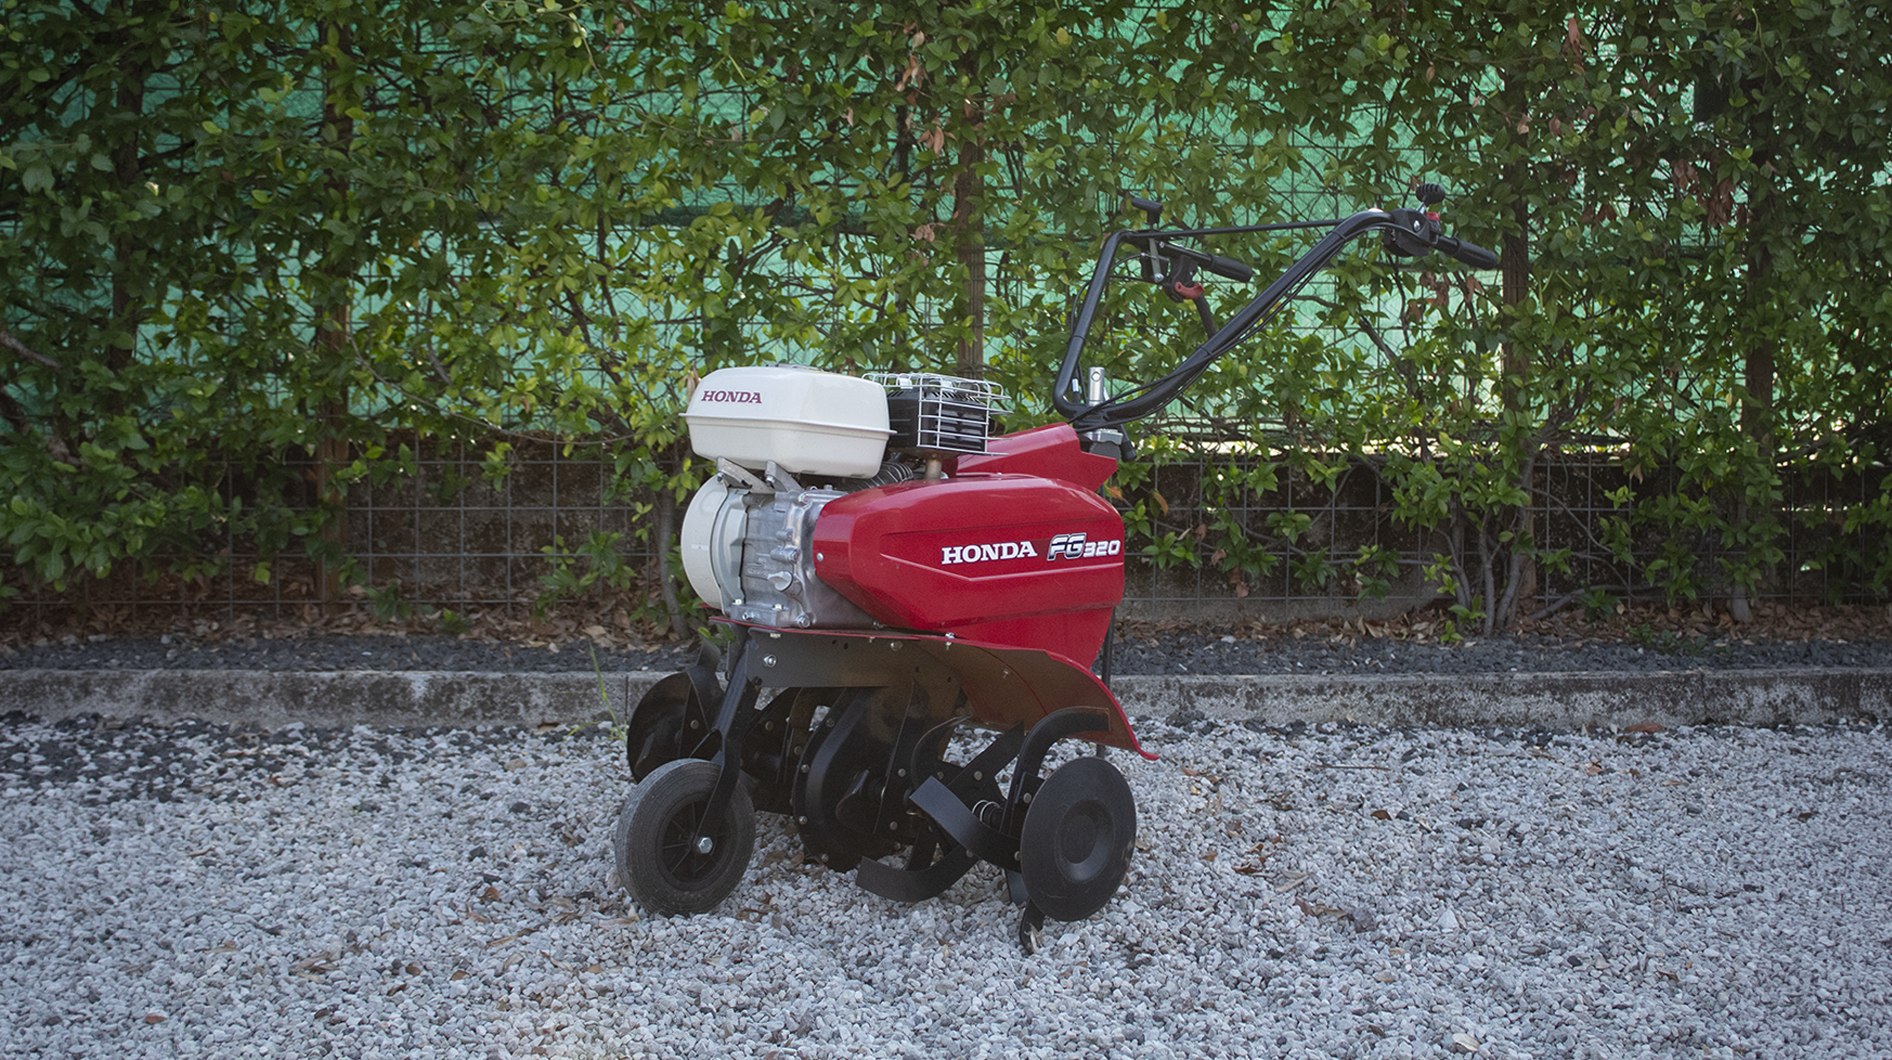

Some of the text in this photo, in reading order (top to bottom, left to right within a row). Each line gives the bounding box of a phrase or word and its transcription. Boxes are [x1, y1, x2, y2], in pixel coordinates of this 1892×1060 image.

[701, 390, 762, 404] HONDA
[941, 532, 1121, 564] HONDA FG320
